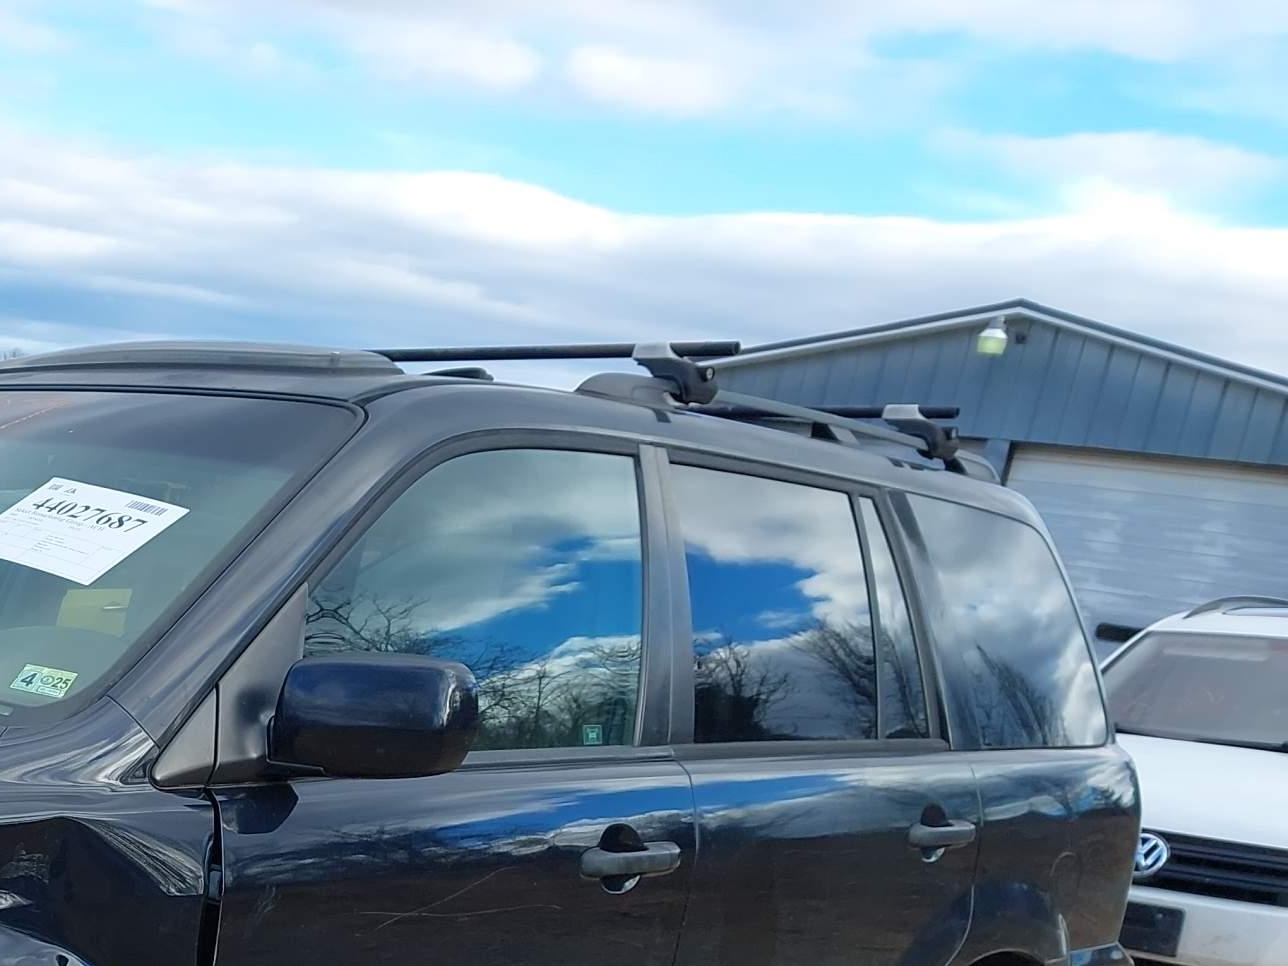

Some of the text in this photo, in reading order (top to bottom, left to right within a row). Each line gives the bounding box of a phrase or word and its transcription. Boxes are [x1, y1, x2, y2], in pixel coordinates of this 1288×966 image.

[32, 496, 149, 533] 44027687
[20, 672, 72, 690] 4 25
